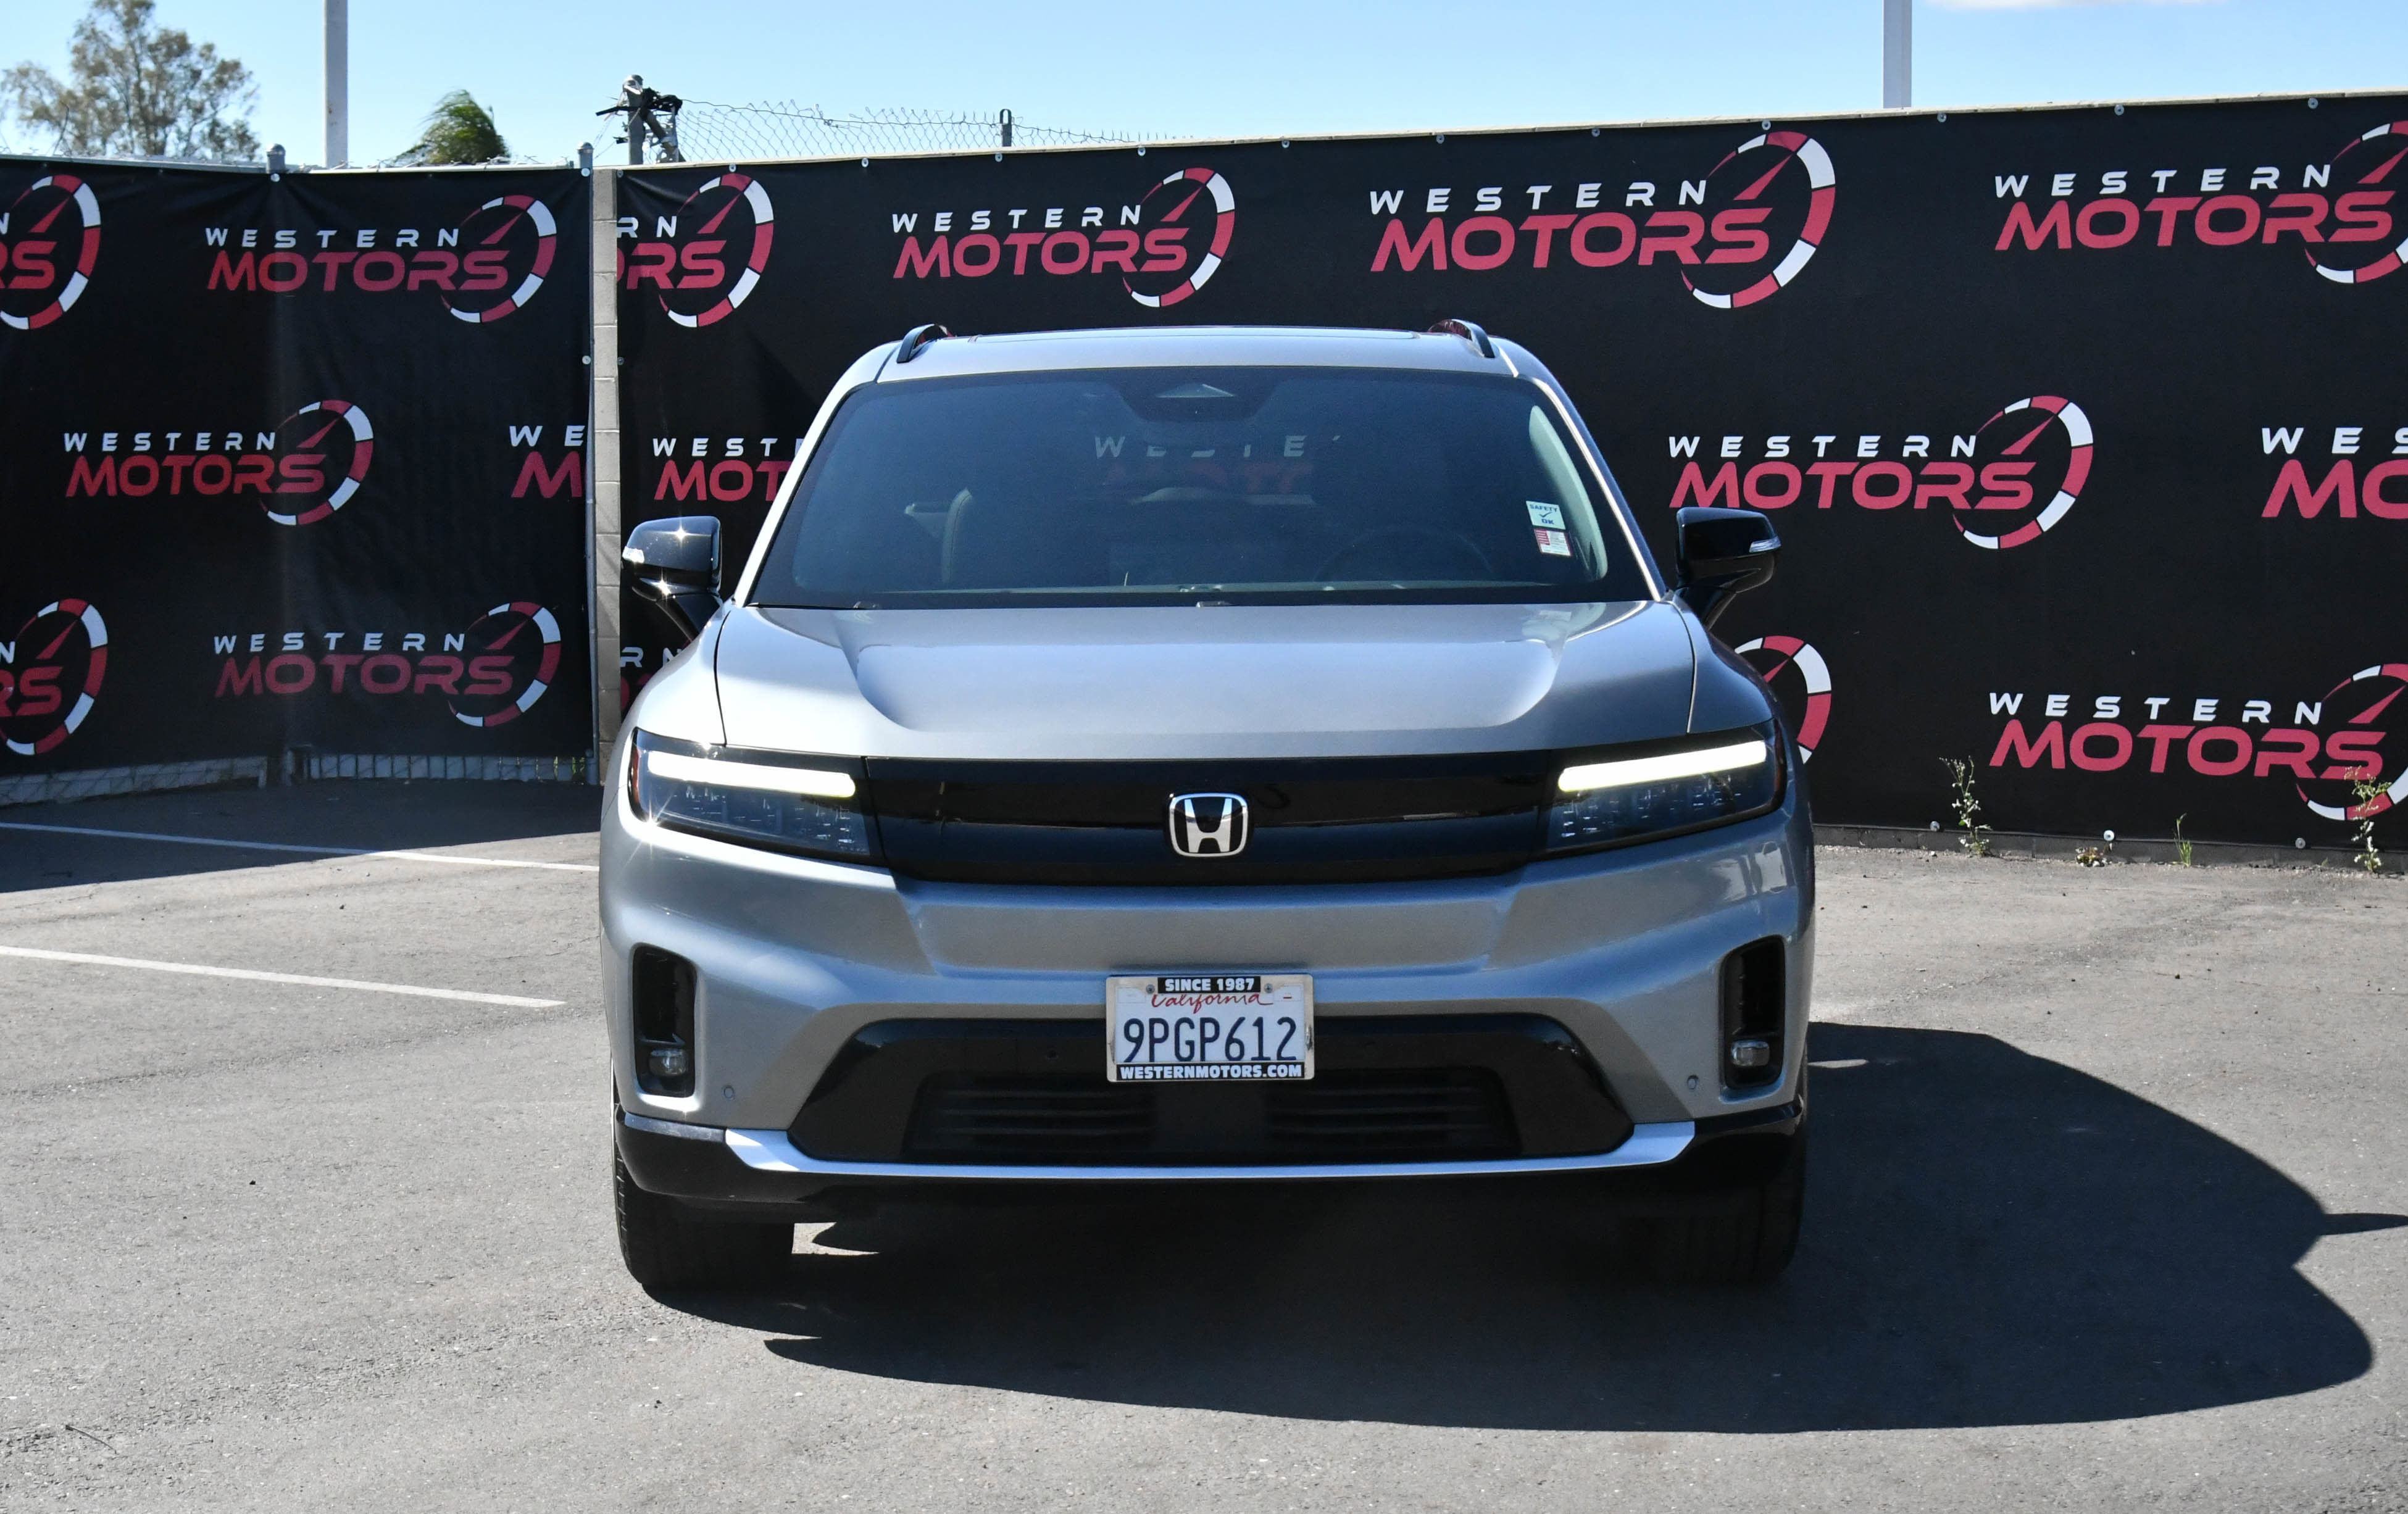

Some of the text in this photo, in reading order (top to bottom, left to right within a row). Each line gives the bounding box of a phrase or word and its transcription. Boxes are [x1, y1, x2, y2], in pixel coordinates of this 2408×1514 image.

[1370, 180, 1707, 215] WESTERN
[1995, 164, 2331, 198] WESTERN
[892, 204, 1141, 233] WESTERN
[1994, 190, 2396, 251] MOTORS
[206, 228, 459, 248] WESTERN
[893, 227, 1189, 279] MOTORS
[1370, 207, 1773, 272] MOTORS
[207, 250, 509, 292] MOTORS
[617, 239, 727, 289] RS
[65, 432, 275, 452] WESTERN
[1669, 435, 1977, 458] WESTERN
[66, 454, 326, 497] MOTORS
[1669, 460, 2036, 510] MOTORS
[1530, 504, 1558, 512] SAFETY
[214, 633, 465, 654] WESTERN
[214, 655, 515, 698] MOTORS
[1989, 693, 2322, 725] WESTERN
[1989, 718, 2387, 781] MOTORS
[1165, 978, 1254, 991] SINCE 1987
[1151, 994, 1273, 1014] California
[1123, 1017, 1297, 1063] 9PGP612
[1120, 1064, 1302, 1079] WESTERNMOTORS.COM
